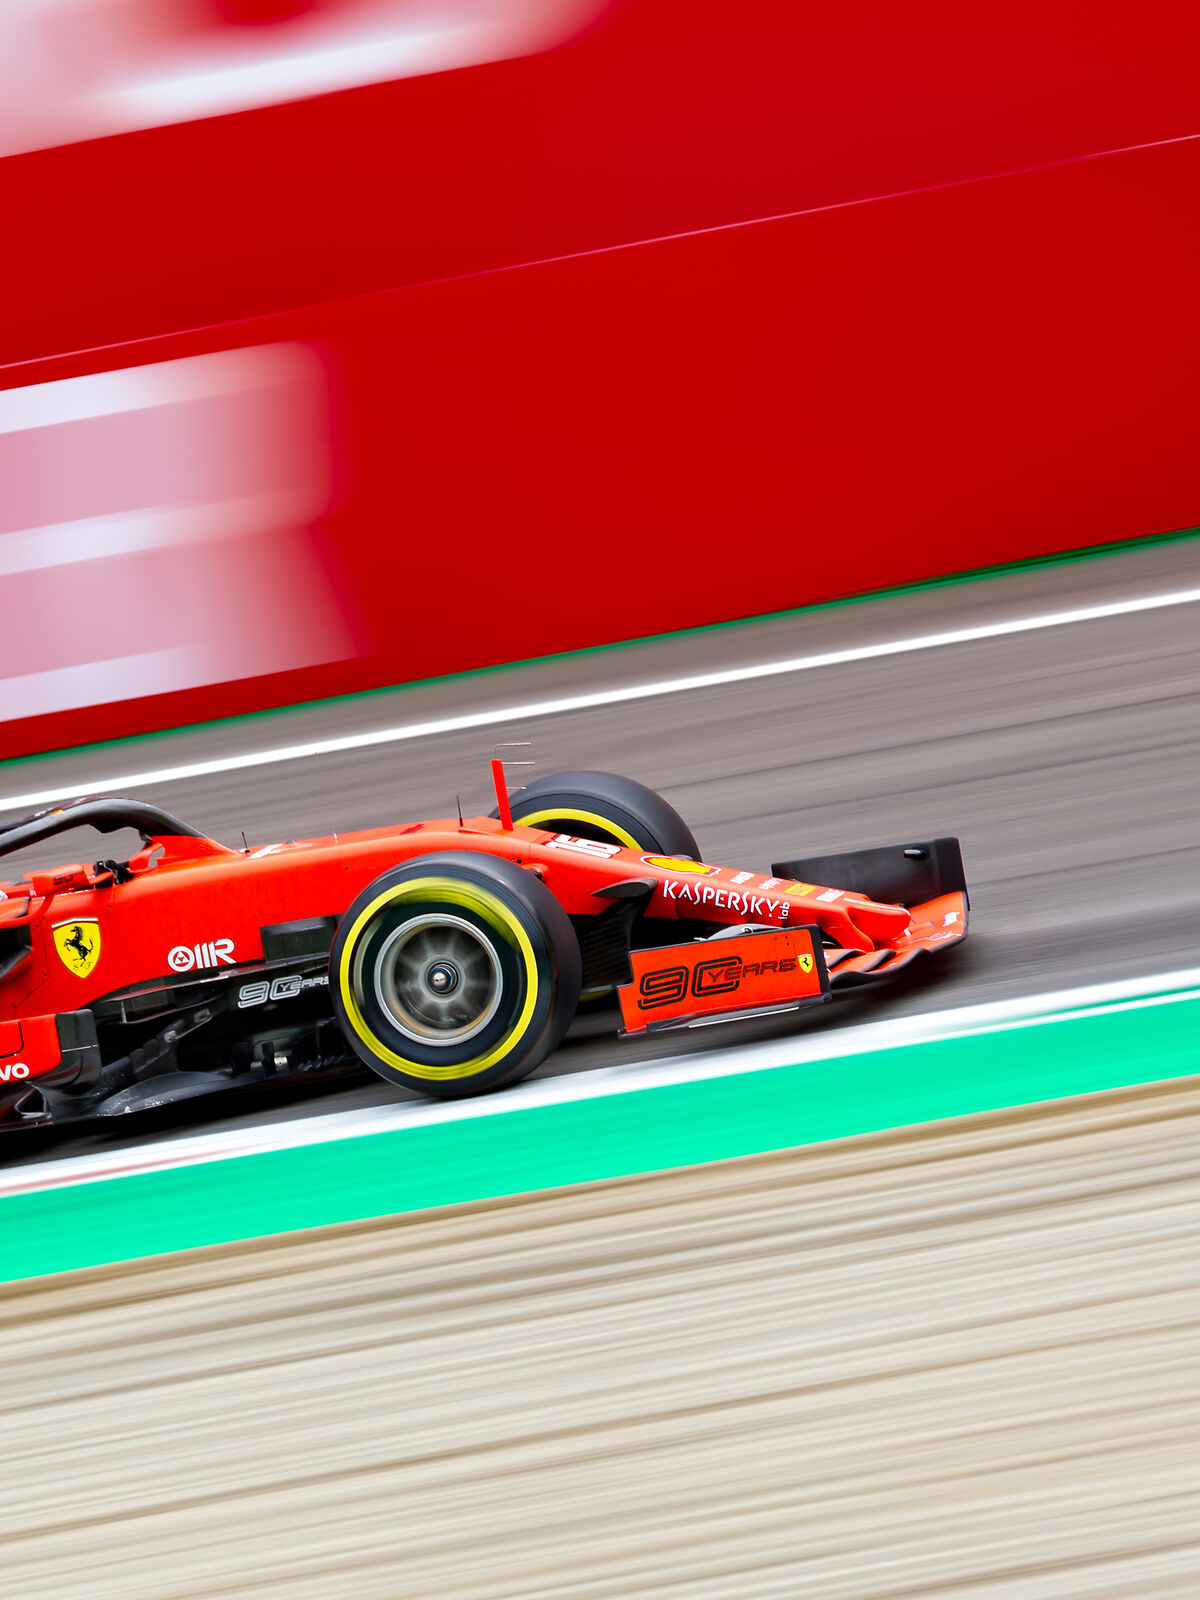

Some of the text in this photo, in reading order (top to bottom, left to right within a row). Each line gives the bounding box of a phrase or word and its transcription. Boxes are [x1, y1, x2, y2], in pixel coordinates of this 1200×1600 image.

[663, 879, 780, 918] KASPERSKY
[778, 901, 791, 920] lab
[237, 975, 302, 1009] 90
[638, 955, 797, 1010] 90 YEARS
